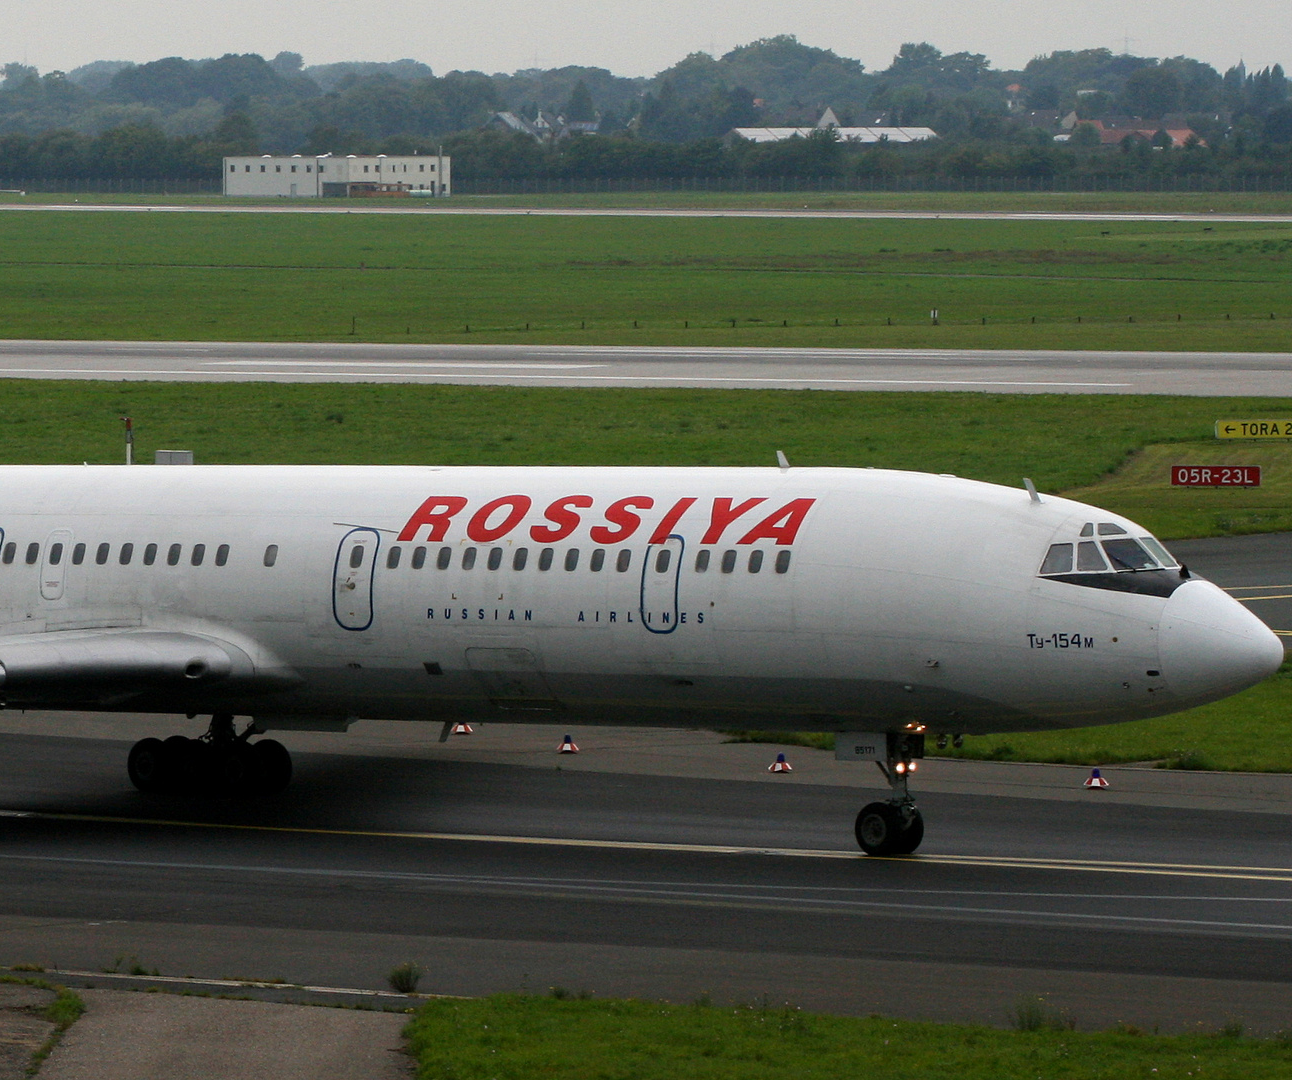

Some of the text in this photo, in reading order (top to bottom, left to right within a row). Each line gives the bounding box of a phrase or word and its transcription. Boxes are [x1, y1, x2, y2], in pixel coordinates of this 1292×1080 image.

[1241, 423, 1280, 436] TORA
[1178, 469, 1254, 483] 05R-23L
[396, 494, 817, 546] ROSSIYA
[427, 607, 705, 624] RUSSIAN AIRLINES
